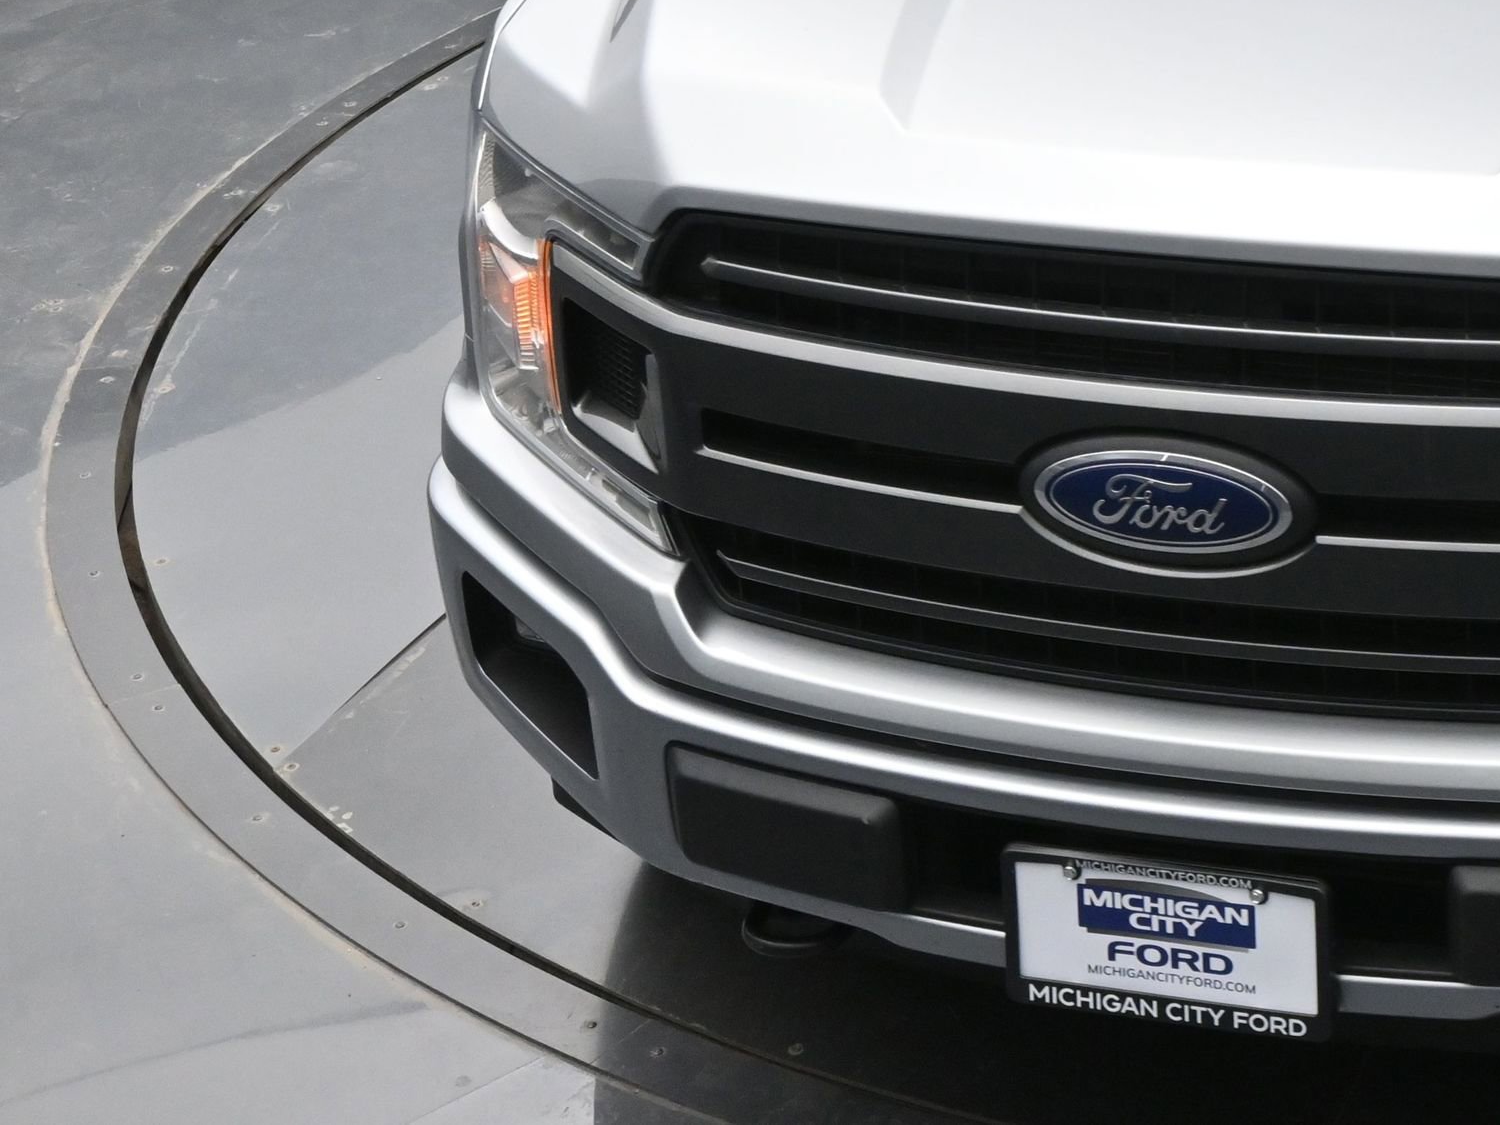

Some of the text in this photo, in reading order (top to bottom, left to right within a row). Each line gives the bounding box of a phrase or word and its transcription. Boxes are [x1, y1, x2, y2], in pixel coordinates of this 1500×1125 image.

[1092, 473, 1228, 535] Ford
[1075, 859, 1253, 889] MICHIGANCITYFORD.COM
[1082, 888, 1249, 926] MICHIGAN
[1129, 912, 1204, 937] CITY
[1107, 941, 1234, 975] FORD
[1087, 963, 1257, 995] MICHIGANCITYFORD.COM
[1028, 983, 1307, 1037] MICHIGAN CITY FORD
